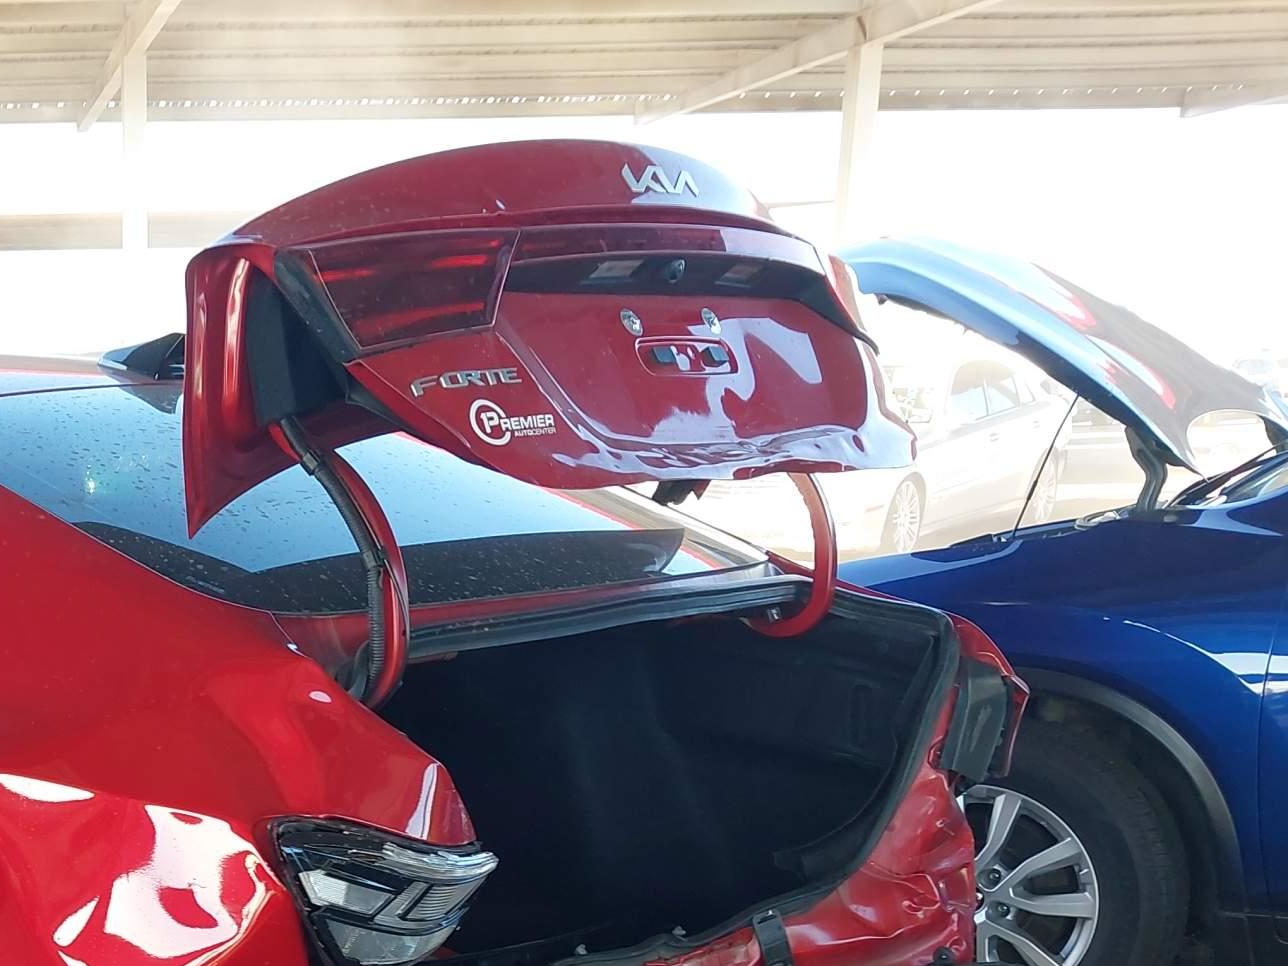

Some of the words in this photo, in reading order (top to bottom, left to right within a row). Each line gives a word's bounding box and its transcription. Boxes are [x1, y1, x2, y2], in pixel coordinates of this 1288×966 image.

[621, 162, 700, 198] KIA
[410, 367, 522, 397] FORTE
[479, 411, 555, 434] PREMIER
[514, 428, 556, 437] AUTOCENTER
